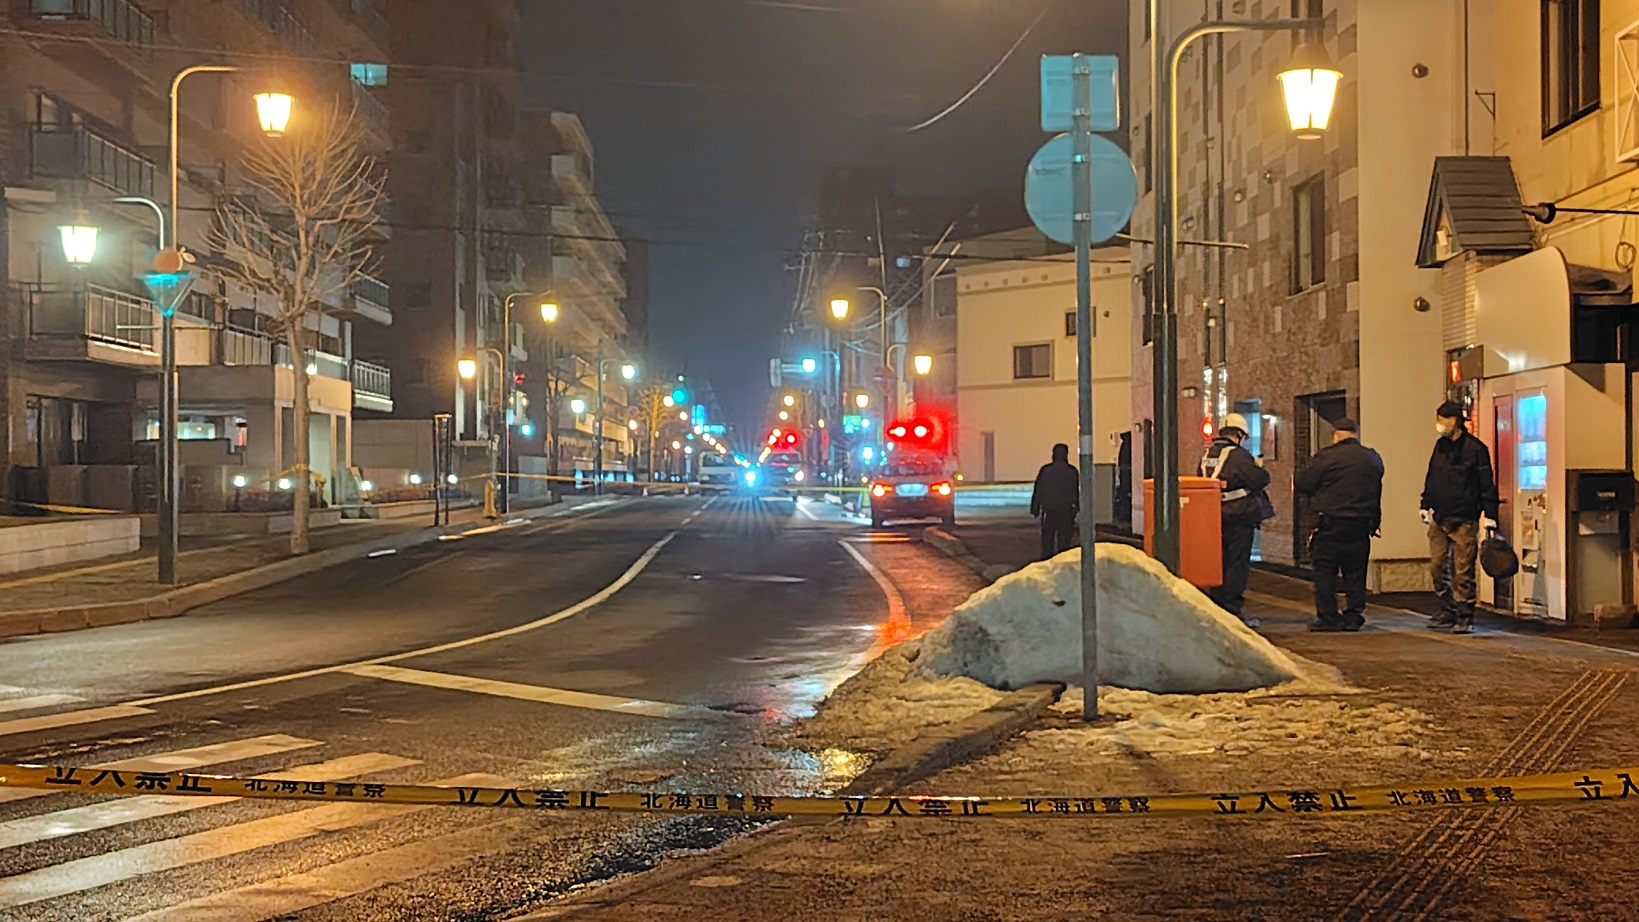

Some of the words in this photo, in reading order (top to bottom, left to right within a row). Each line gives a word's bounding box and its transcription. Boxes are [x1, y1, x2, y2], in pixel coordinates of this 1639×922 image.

[1210, 789, 1363, 814] 立入禁止
[1386, 786, 1517, 806] 北海道警察
